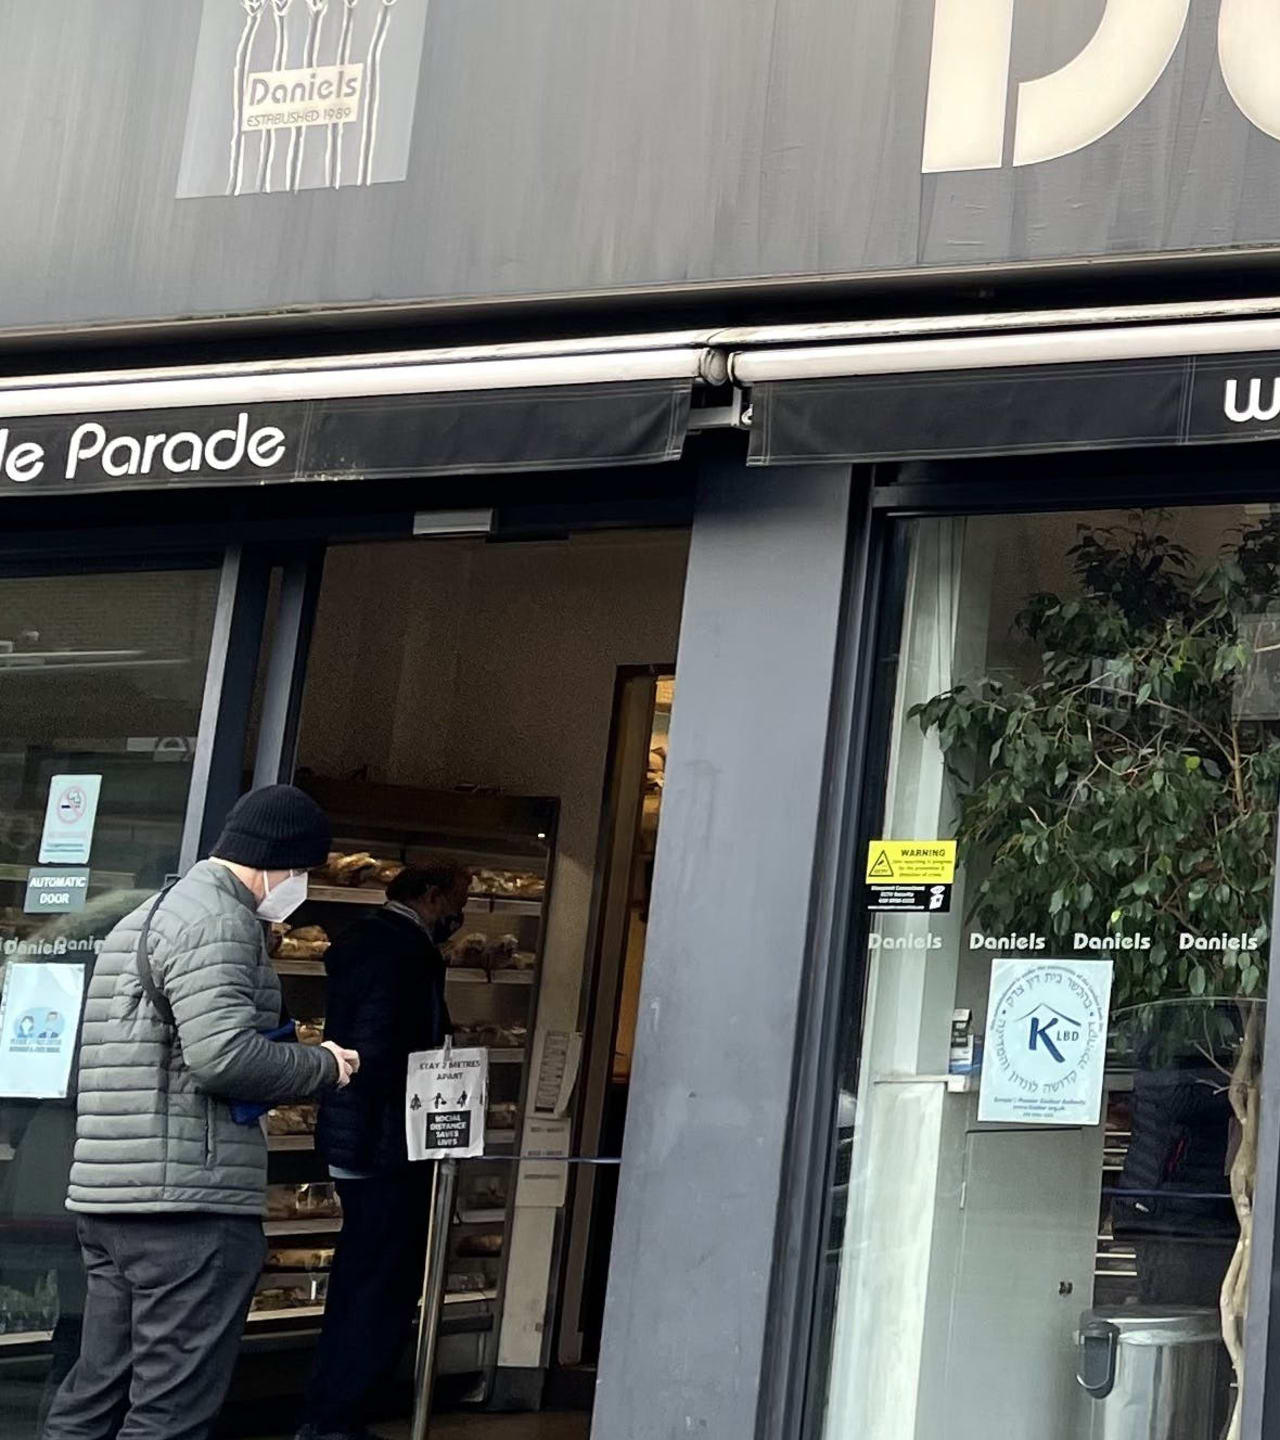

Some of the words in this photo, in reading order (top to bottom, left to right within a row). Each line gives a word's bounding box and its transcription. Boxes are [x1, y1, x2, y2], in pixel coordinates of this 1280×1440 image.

[249, 70, 358, 107] Daniels
[246, 110, 319, 127] ESTABLISHED
[323, 107, 352, 120] 1989
[65, 412, 286, 479] Parade
[901, 849, 946, 857] WARNING
[29, 876, 87, 888] AUTOMATIC
[40, 893, 70, 904] DOOR
[867, 933, 943, 950] Daniels
[968, 932, 1047, 951] Daniels
[1072, 931, 1152, 951] Daniels
[1178, 931, 1259, 951] Daniels
[1028, 1017, 1066, 1063] K
[1056, 1031, 1080, 1042] LBD
